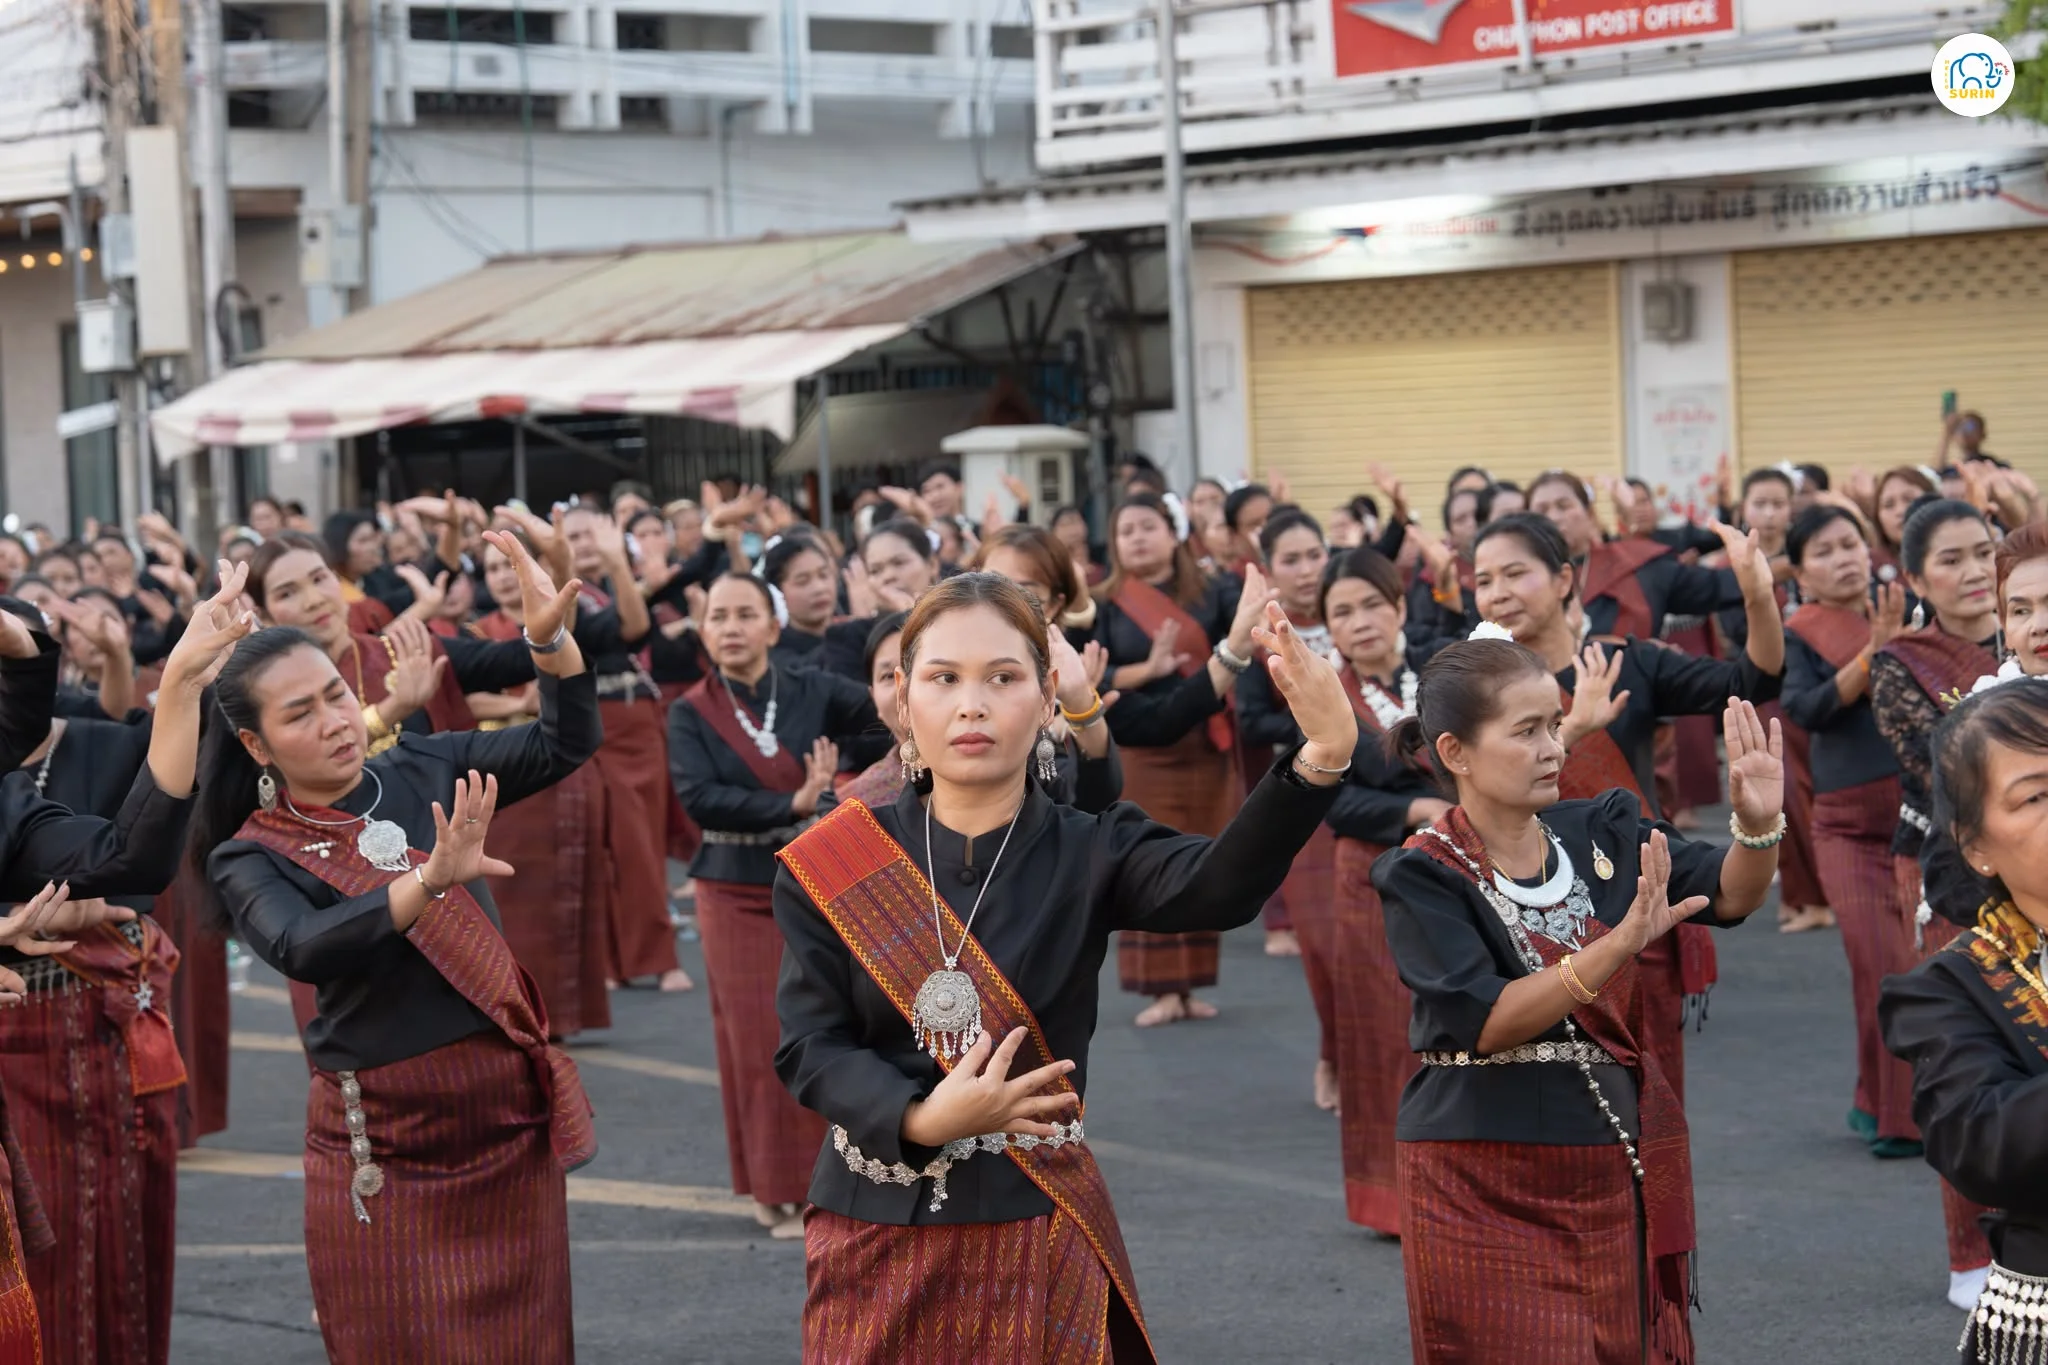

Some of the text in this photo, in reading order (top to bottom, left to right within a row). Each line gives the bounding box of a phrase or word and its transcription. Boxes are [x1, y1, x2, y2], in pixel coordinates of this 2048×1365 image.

[1473, 1, 1718, 51] CHUPHON POST OFFICE
